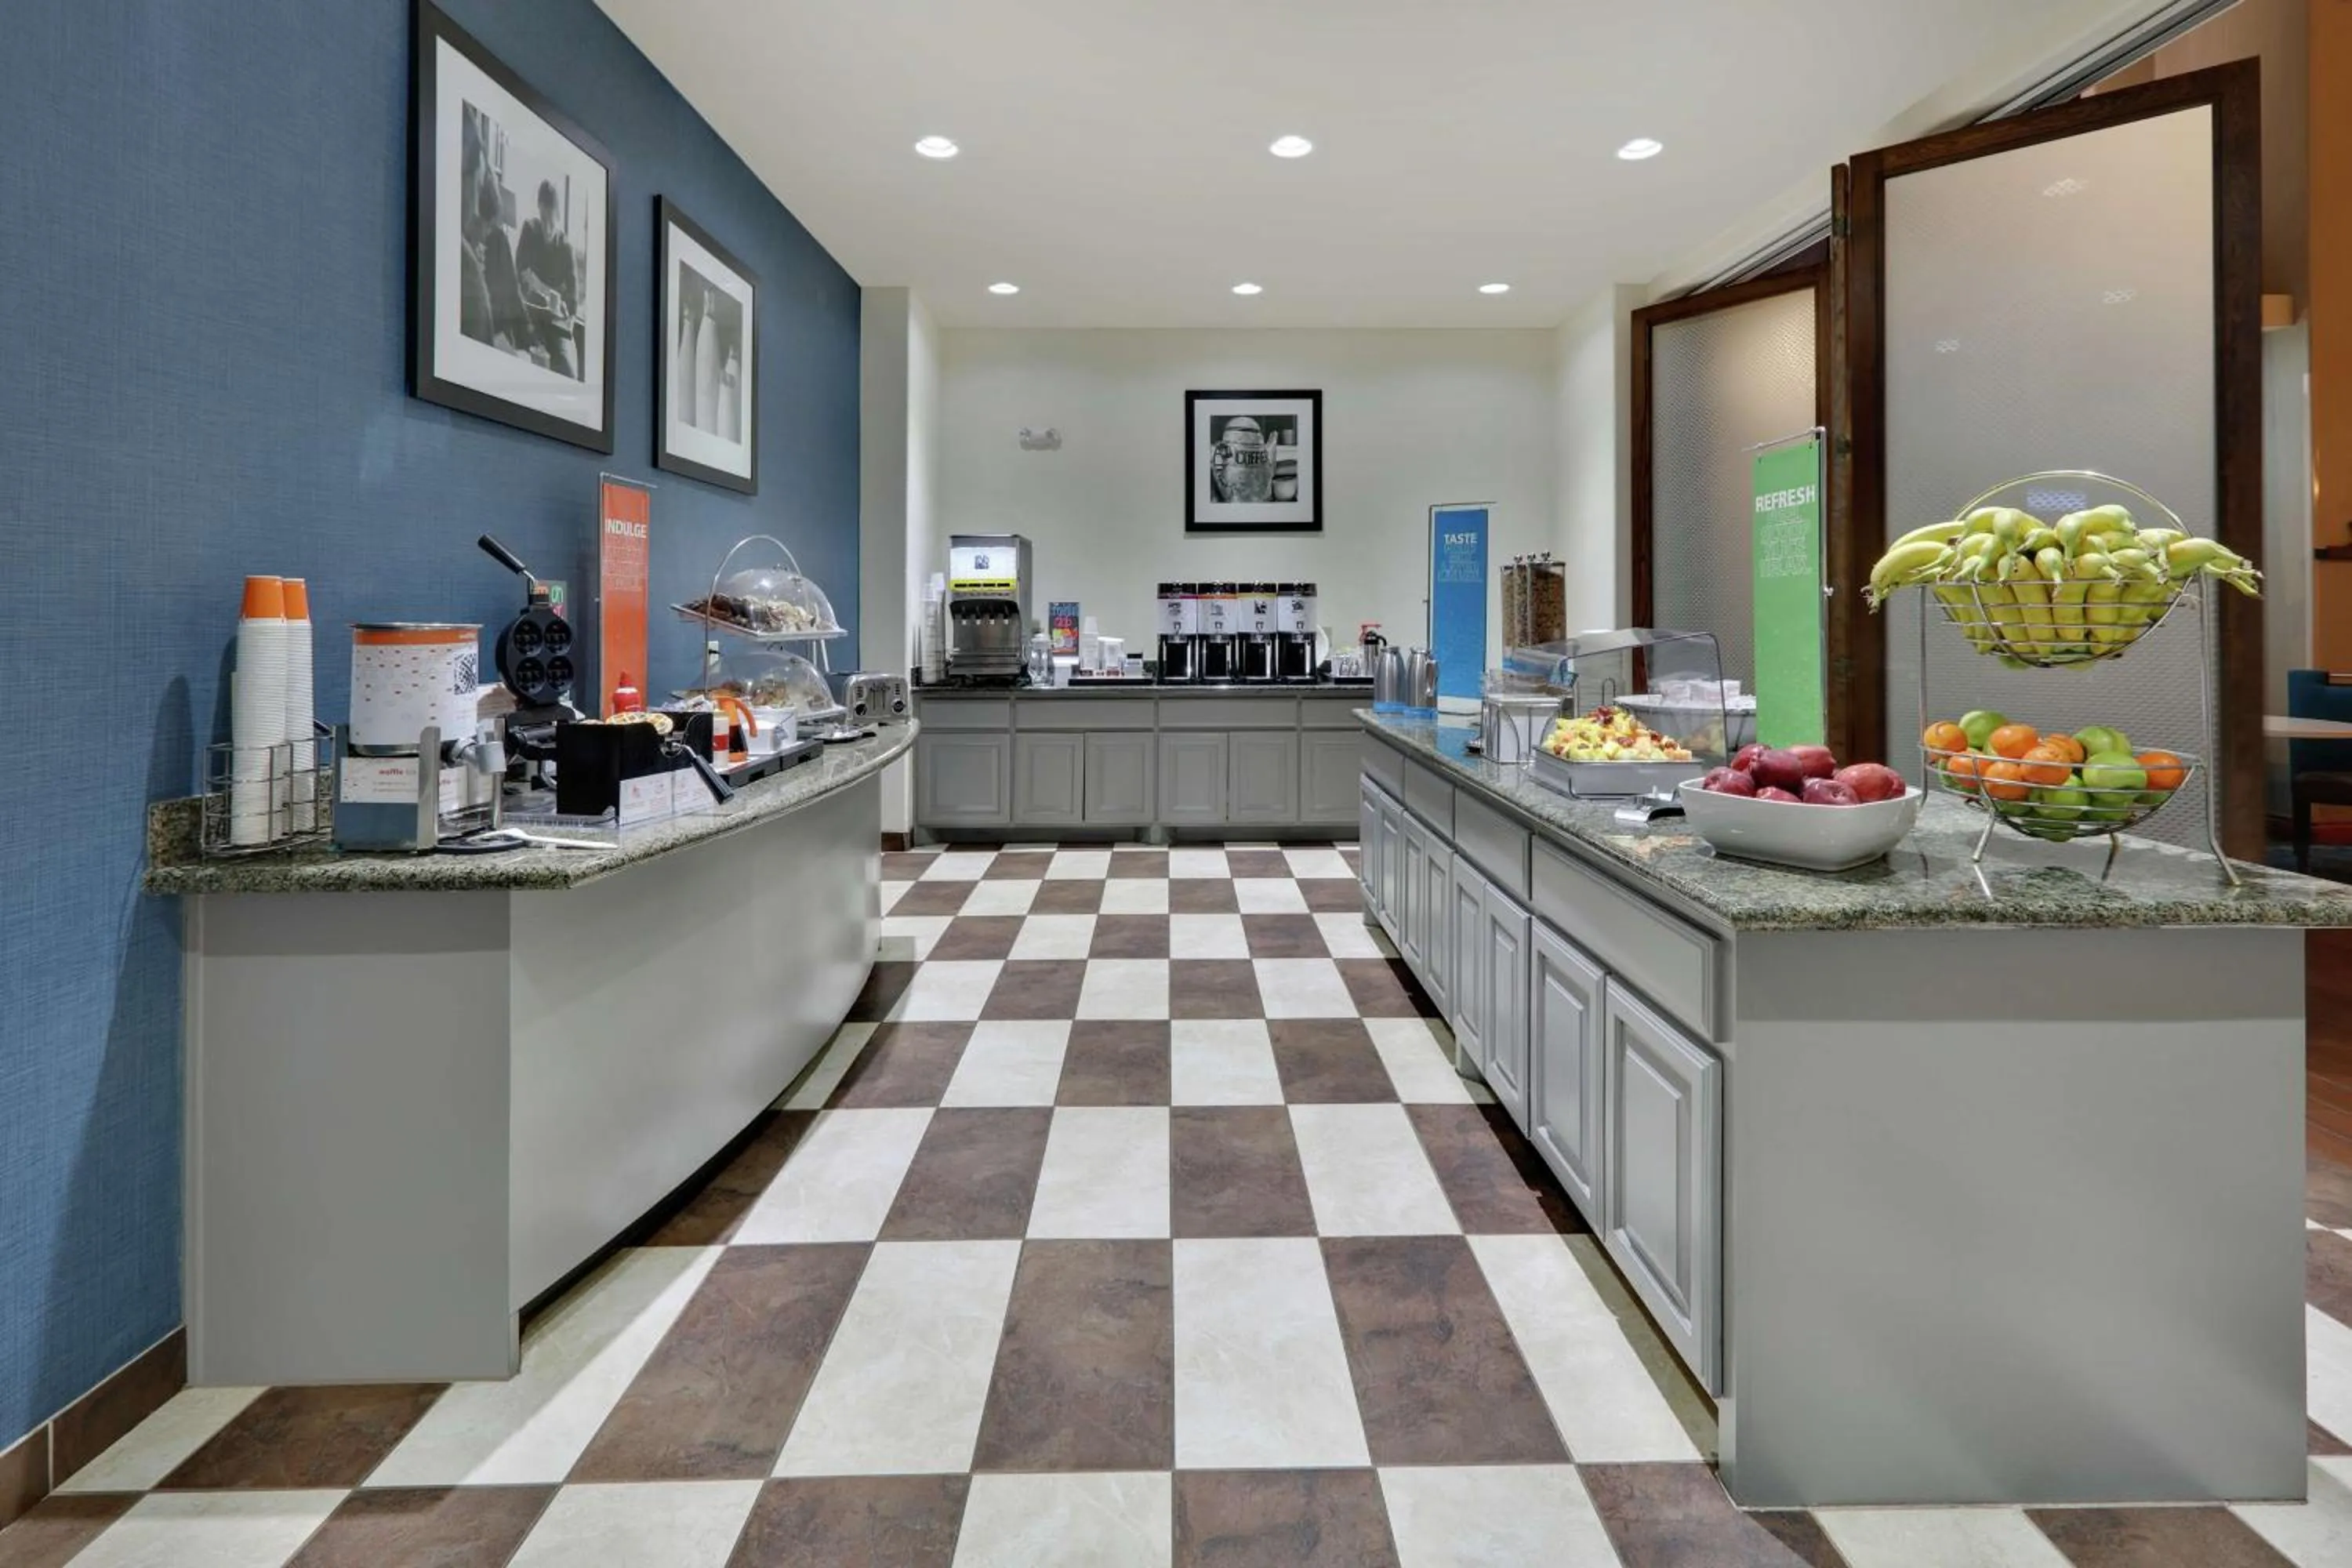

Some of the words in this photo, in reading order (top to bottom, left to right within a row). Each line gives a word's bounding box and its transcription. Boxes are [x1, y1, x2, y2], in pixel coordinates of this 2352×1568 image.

[1755, 485, 1815, 512] REFRESH
[604, 518, 647, 539] INDULGE
[1444, 532, 1478, 544] TASTE
